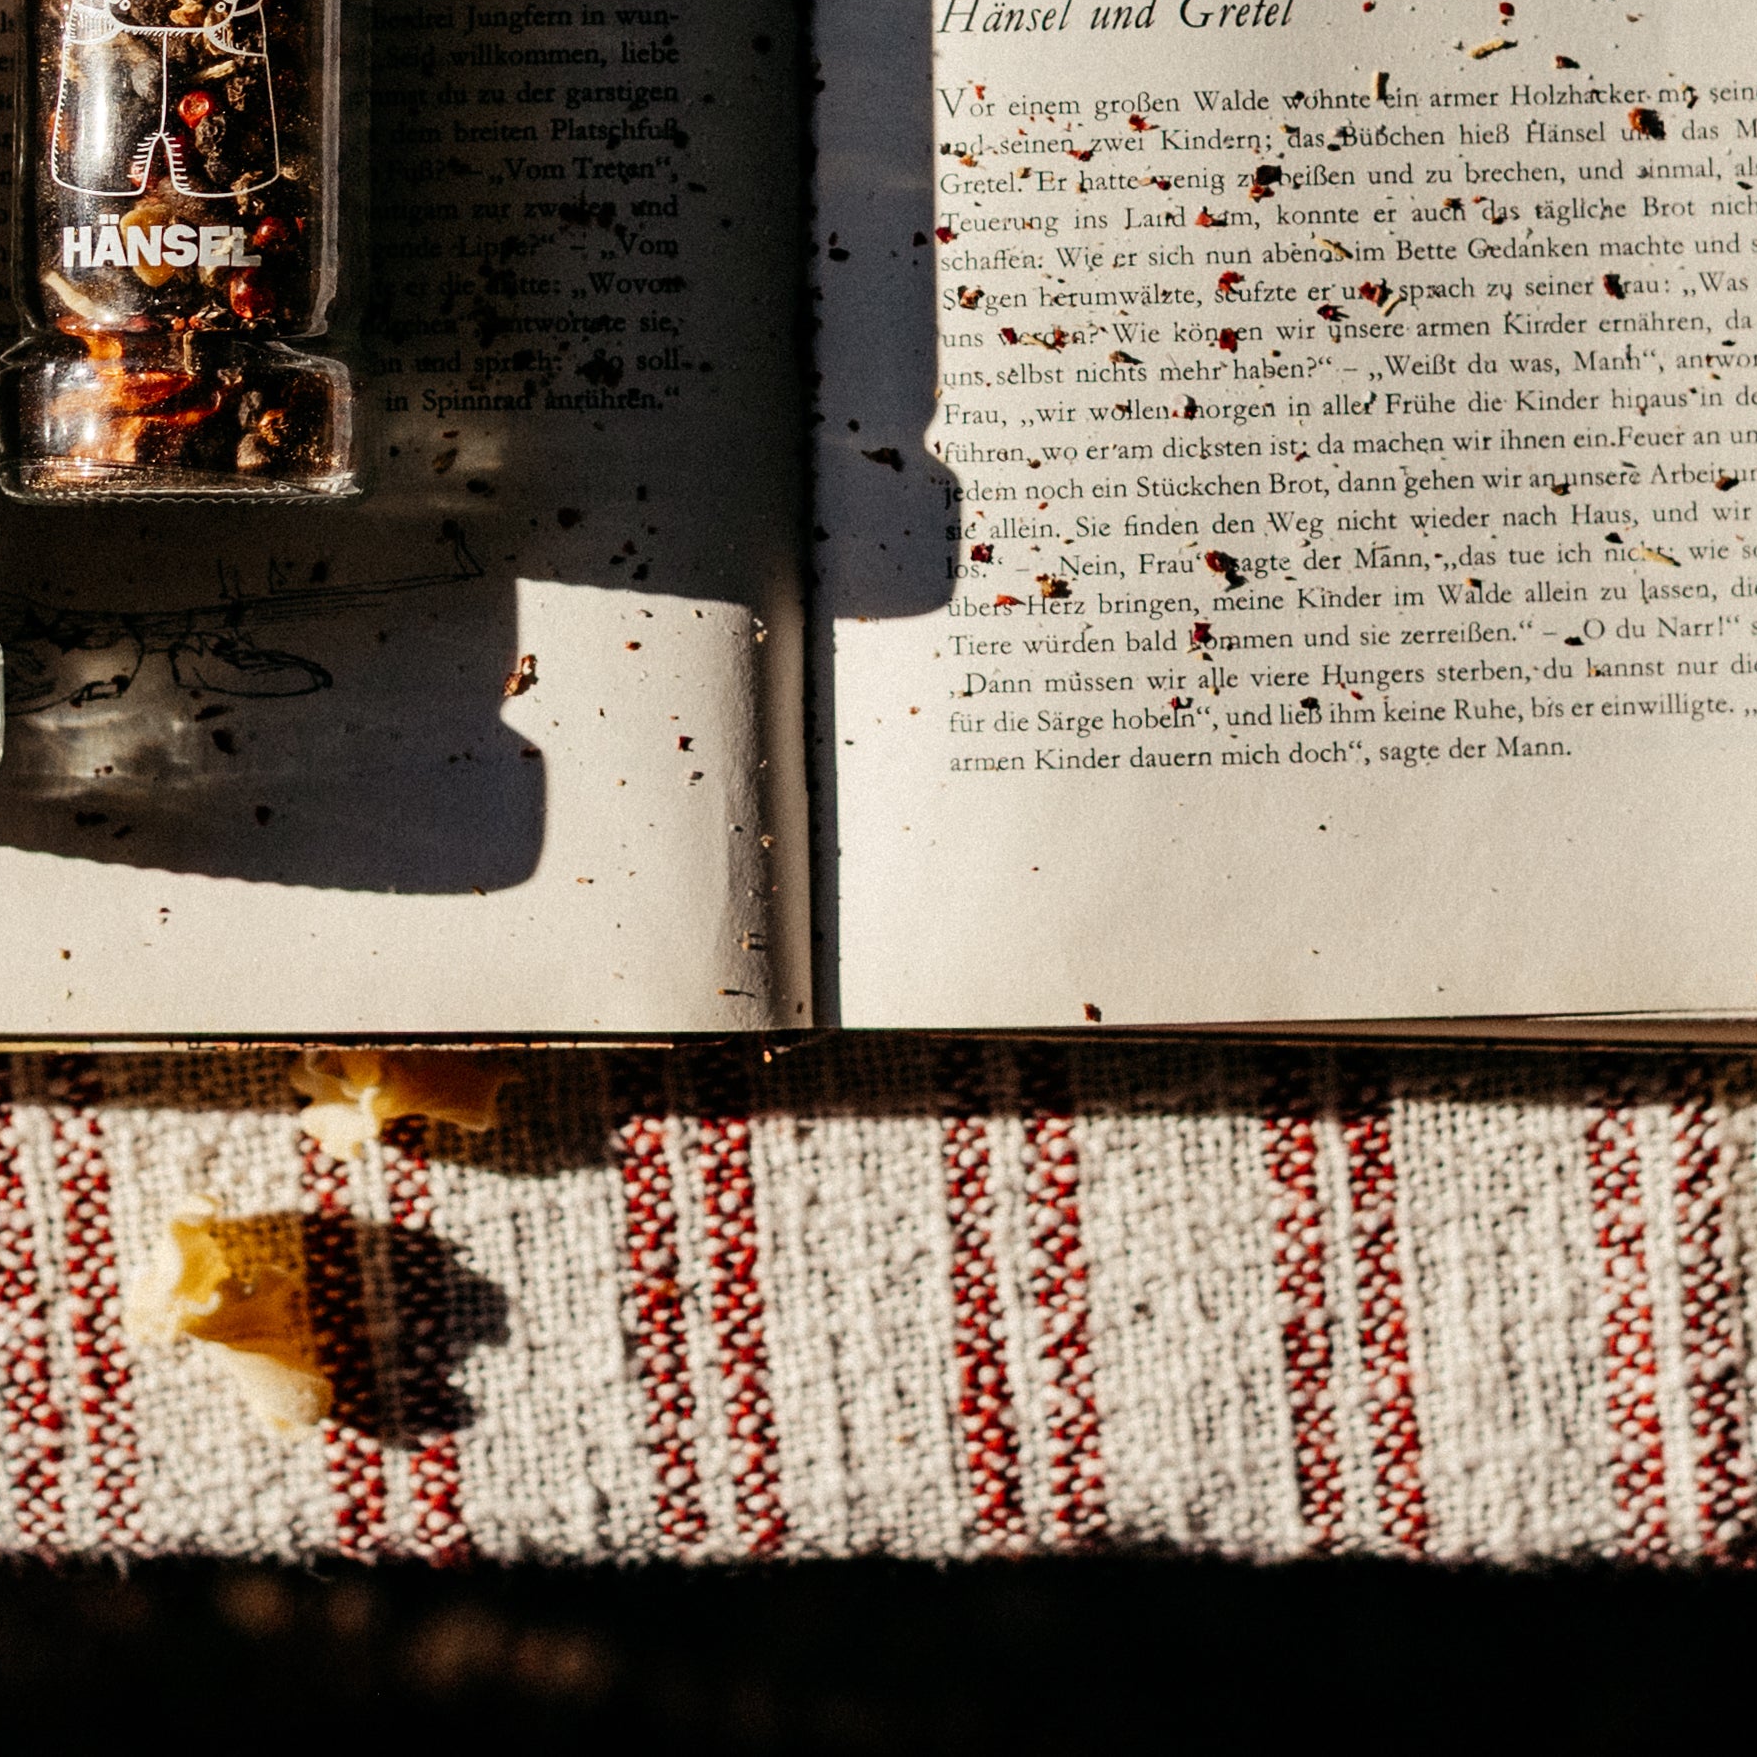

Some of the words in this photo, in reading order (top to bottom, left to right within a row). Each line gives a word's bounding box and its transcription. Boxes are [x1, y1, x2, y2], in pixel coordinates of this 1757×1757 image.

[1009, 94, 1080, 115] einem
[1095, 91, 1179, 121] großen
[1194, 89, 1269, 111] Walde
[1430, 92, 1498, 107] armer
[1090, 131, 1144, 152] zwei
[1162, 128, 1272, 155] Kindern;
[1460, 122, 1509, 144] hieß
[1527, 121, 1605, 143] Hänsel
[1038, 170, 1067, 192] Er
[1465, 161, 1565, 188] brechen,
[1277, 202, 1358, 224] konnte
[1535, 197, 1626, 227] tägliche
[1643, 196, 1694, 218] Brot
[62, 214, 262, 267] HÄNSEL
[942, 247, 1042, 269] schaffen:
[1149, 243, 1194, 265] sich
[1397, 238, 1456, 260] Bette
[1600, 234, 1683, 256] machte
[1526, 275, 1594, 296] seiner
[1113, 321, 1159, 343] Wie
[1417, 322, 1489, 337] armen
[1599, 310, 1711, 337] ernähren,
[997, 362, 1062, 384] selbst
[1160, 358, 1221, 380] mehr
[1510, 358, 1560, 378] was,
[946, 401, 1007, 428] Frau,
[1386, 391, 1455, 413] Frühe
[1516, 388, 1598, 410] Kinder
[1163, 435, 1261, 457] dicksten
[1354, 431, 1443, 453] machen
[1501, 428, 1565, 450] ihnen
[1618, 426, 1685, 448] Feuer
[1026, 476, 1083, 498] noch
[1137, 473, 1260, 495] Stückchen
[1270, 471, 1329, 498] Brot,
[1338, 469, 1396, 491] dann
[991, 516, 1060, 538] allein.
[1076, 515, 1110, 537] Sie
[1125, 513, 1198, 535] finden
[1268, 510, 1323, 539] Weg
[1338, 508, 1396, 530] nicht
[1410, 506, 1489, 528] wieder
[1503, 504, 1556, 526] nach
[1572, 503, 1638, 530] Haus,
[1653, 501, 1697, 523] und
[1509, 546, 1544, 565] tue
[1558, 541, 1591, 563] ich
[1689, 539, 1729, 560] wie
[1099, 589, 1199, 619] bringen,
[1213, 588, 1283, 609] meine
[1525, 580, 1587, 602] allein
[949, 633, 1011, 655] Tiere
[1023, 631, 1114, 653] würden
[1127, 629, 1177, 651] bald
[1305, 624, 1349, 646] und
[1045, 669, 1133, 690] müssen
[1251, 664, 1309, 685] viere
[1437, 658, 1531, 685] sterben,
[950, 710, 985, 732] für
[1038, 707, 1103, 737] Särge
[1226, 703, 1272, 725] und
[1330, 700, 1375, 722] ihm
[1384, 699, 1445, 721] keine
[1455, 697, 1523, 724] Ruhe,
[1601, 692, 1734, 722] einwilligte.
[951, 755, 1024, 770] armen
[1037, 745, 1120, 767] Kinder
[1130, 742, 1212, 764] dauern
[1222, 740, 1279, 762] mich
[1380, 738, 1439, 764] sagte
[1497, 731, 1570, 753] Mann.
